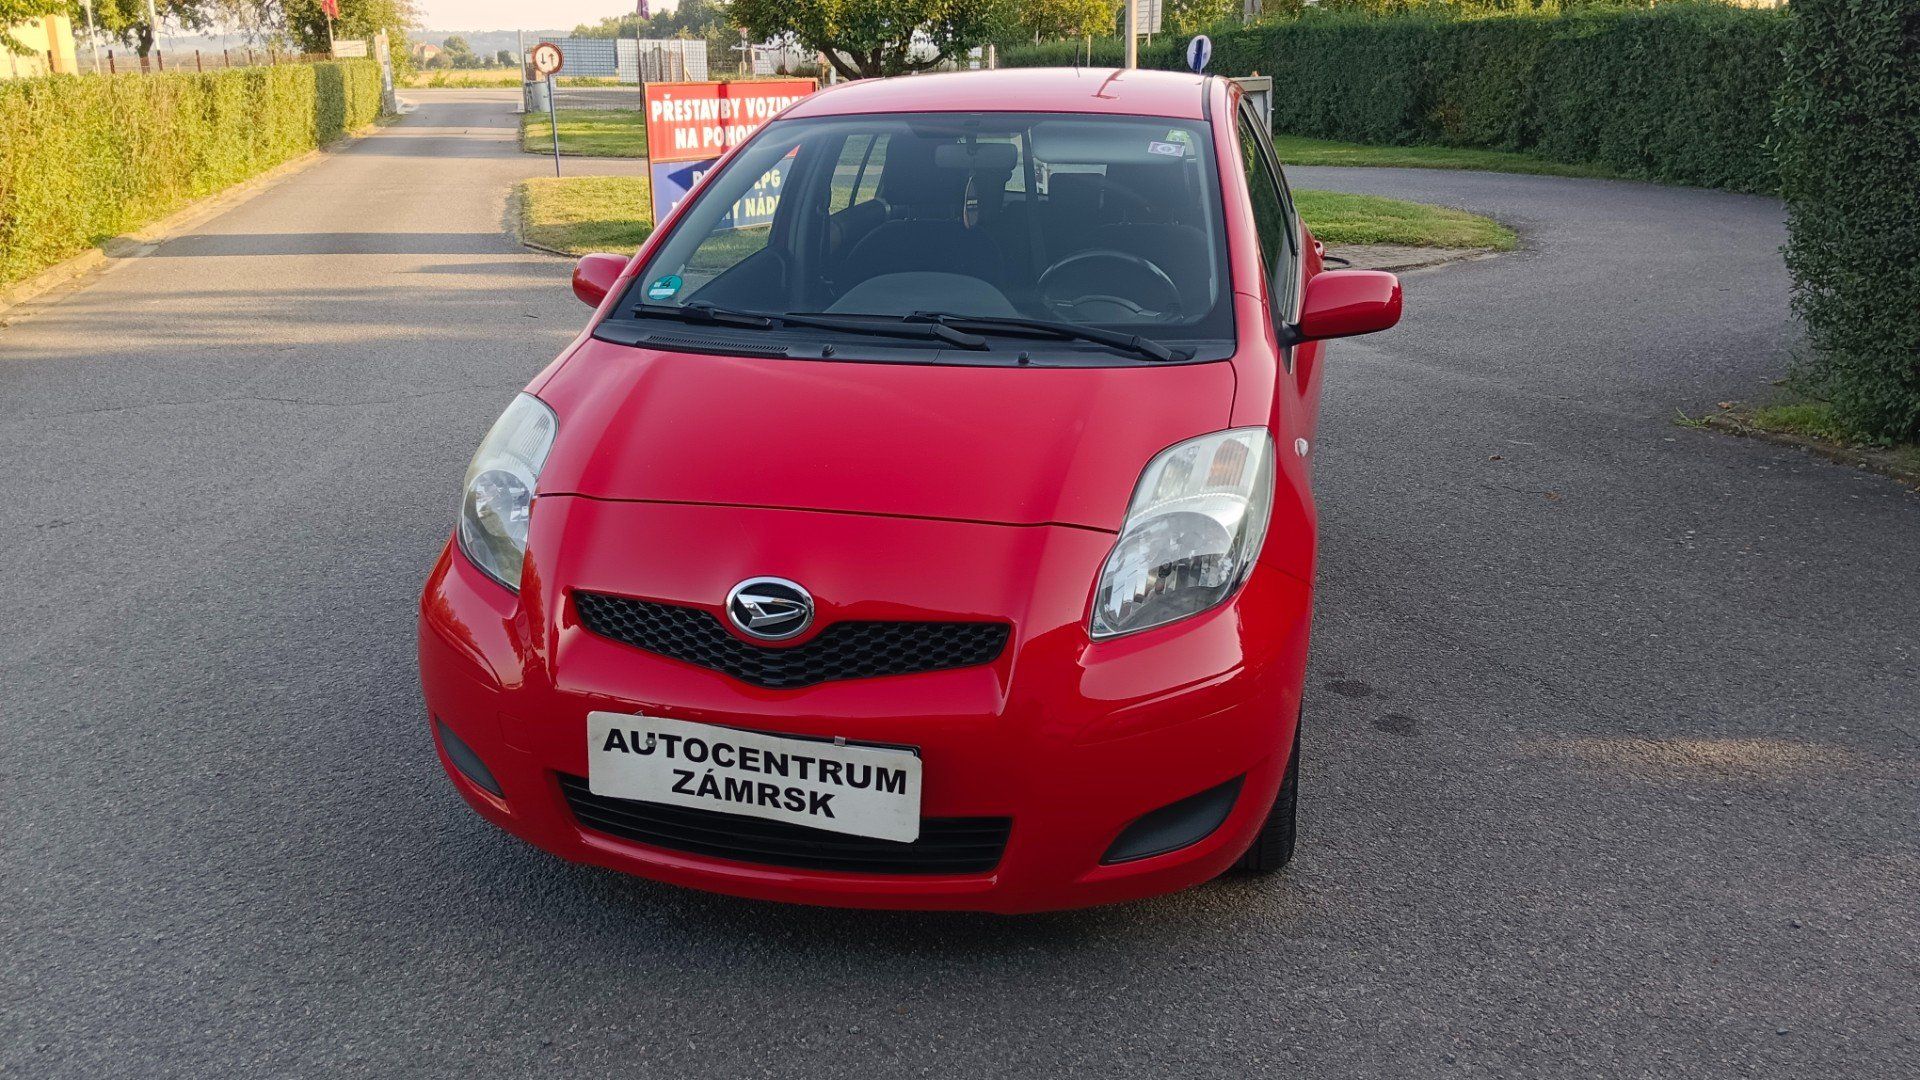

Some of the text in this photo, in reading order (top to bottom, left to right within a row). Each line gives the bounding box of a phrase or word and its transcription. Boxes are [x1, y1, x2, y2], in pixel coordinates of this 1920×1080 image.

[651, 93, 741, 122] PŘESTAVBY
[675, 127, 699, 149] NA
[603, 728, 907, 796] AUTOCENTRUM
[672, 768, 836, 819] ZÁMRSK
